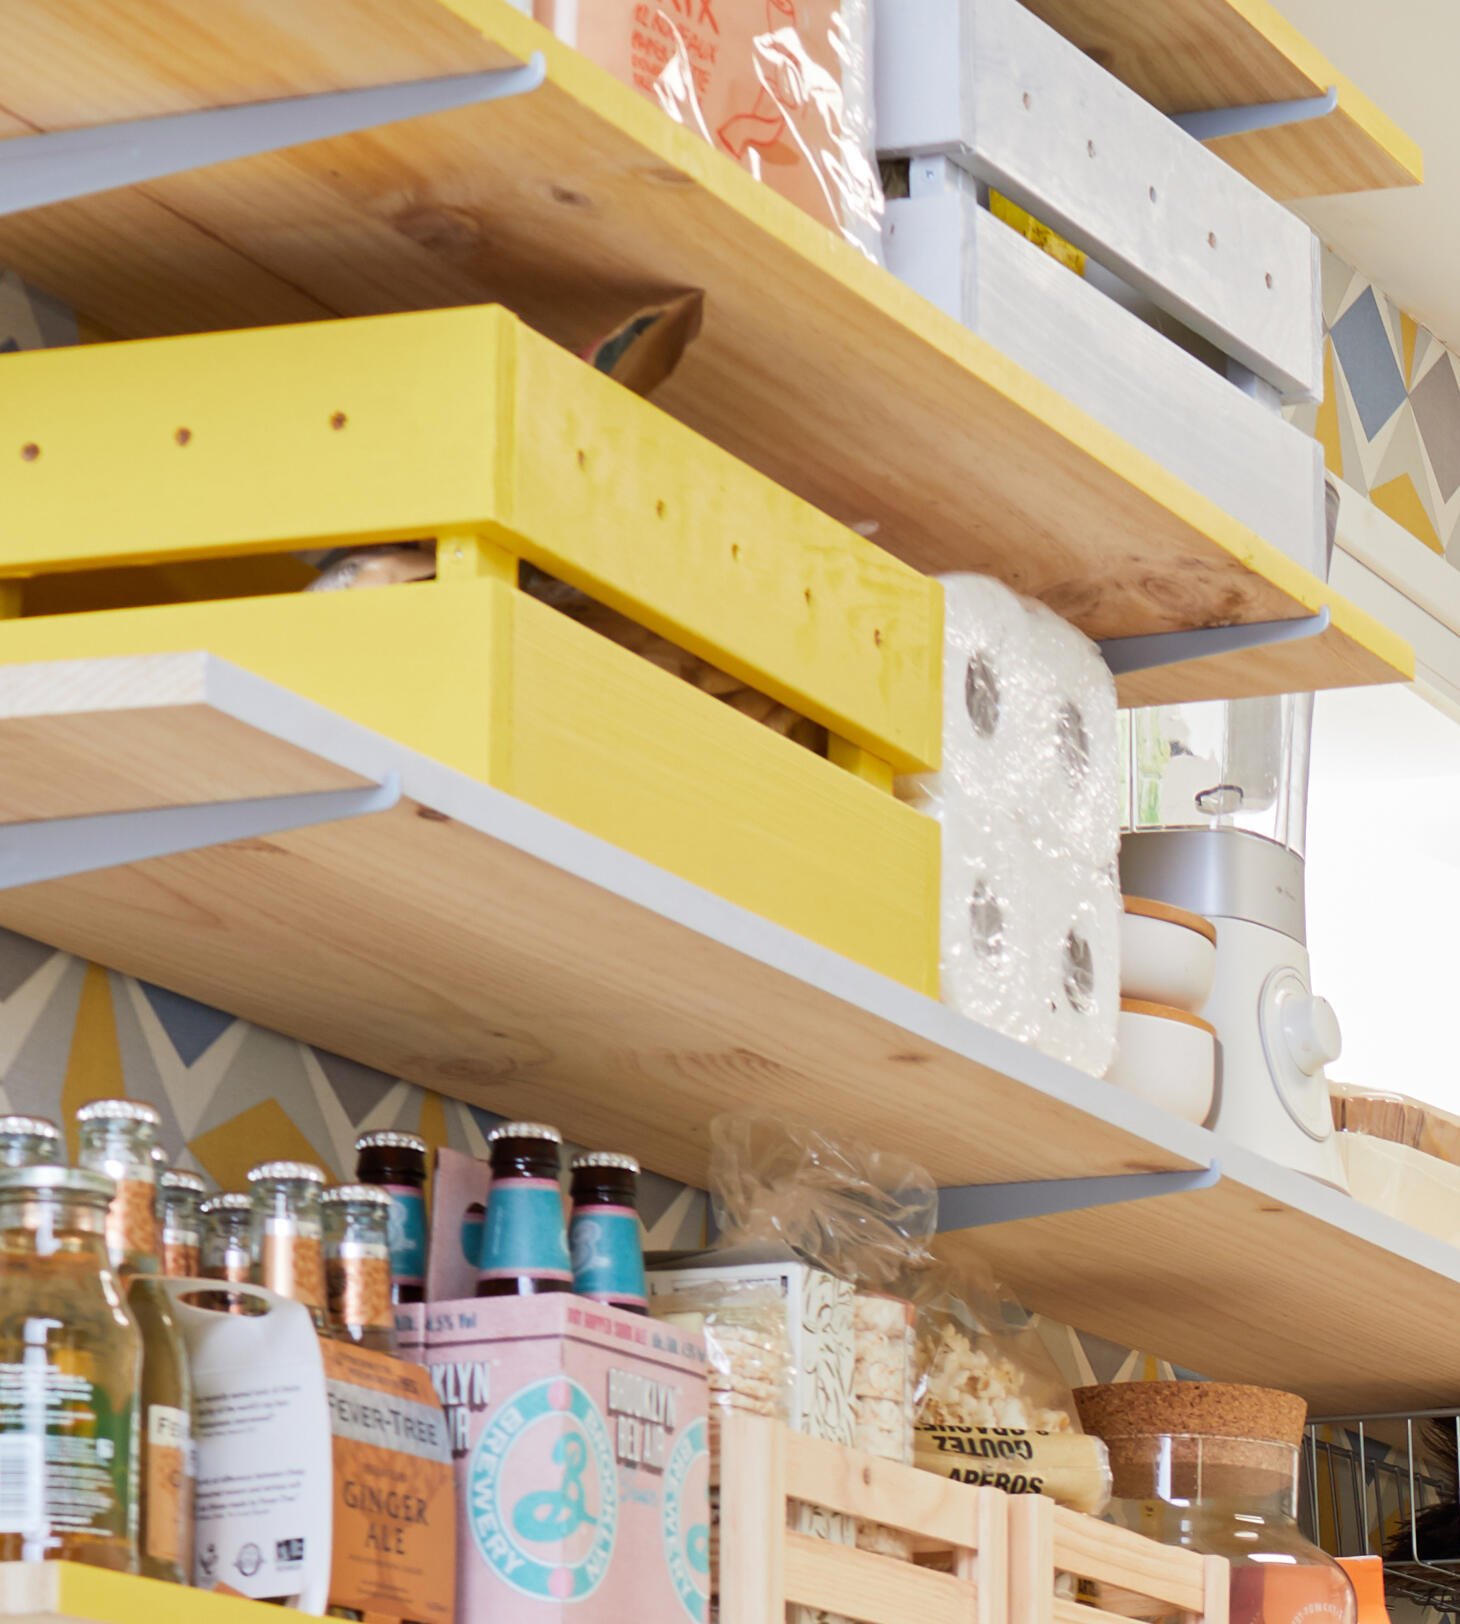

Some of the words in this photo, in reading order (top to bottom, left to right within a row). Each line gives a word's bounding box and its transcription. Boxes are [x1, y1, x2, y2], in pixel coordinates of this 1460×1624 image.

[342, 1480, 430, 1526] GINGER
[469, 1403, 526, 1579] BREWERY
[364, 1521, 406, 1556] ALE
